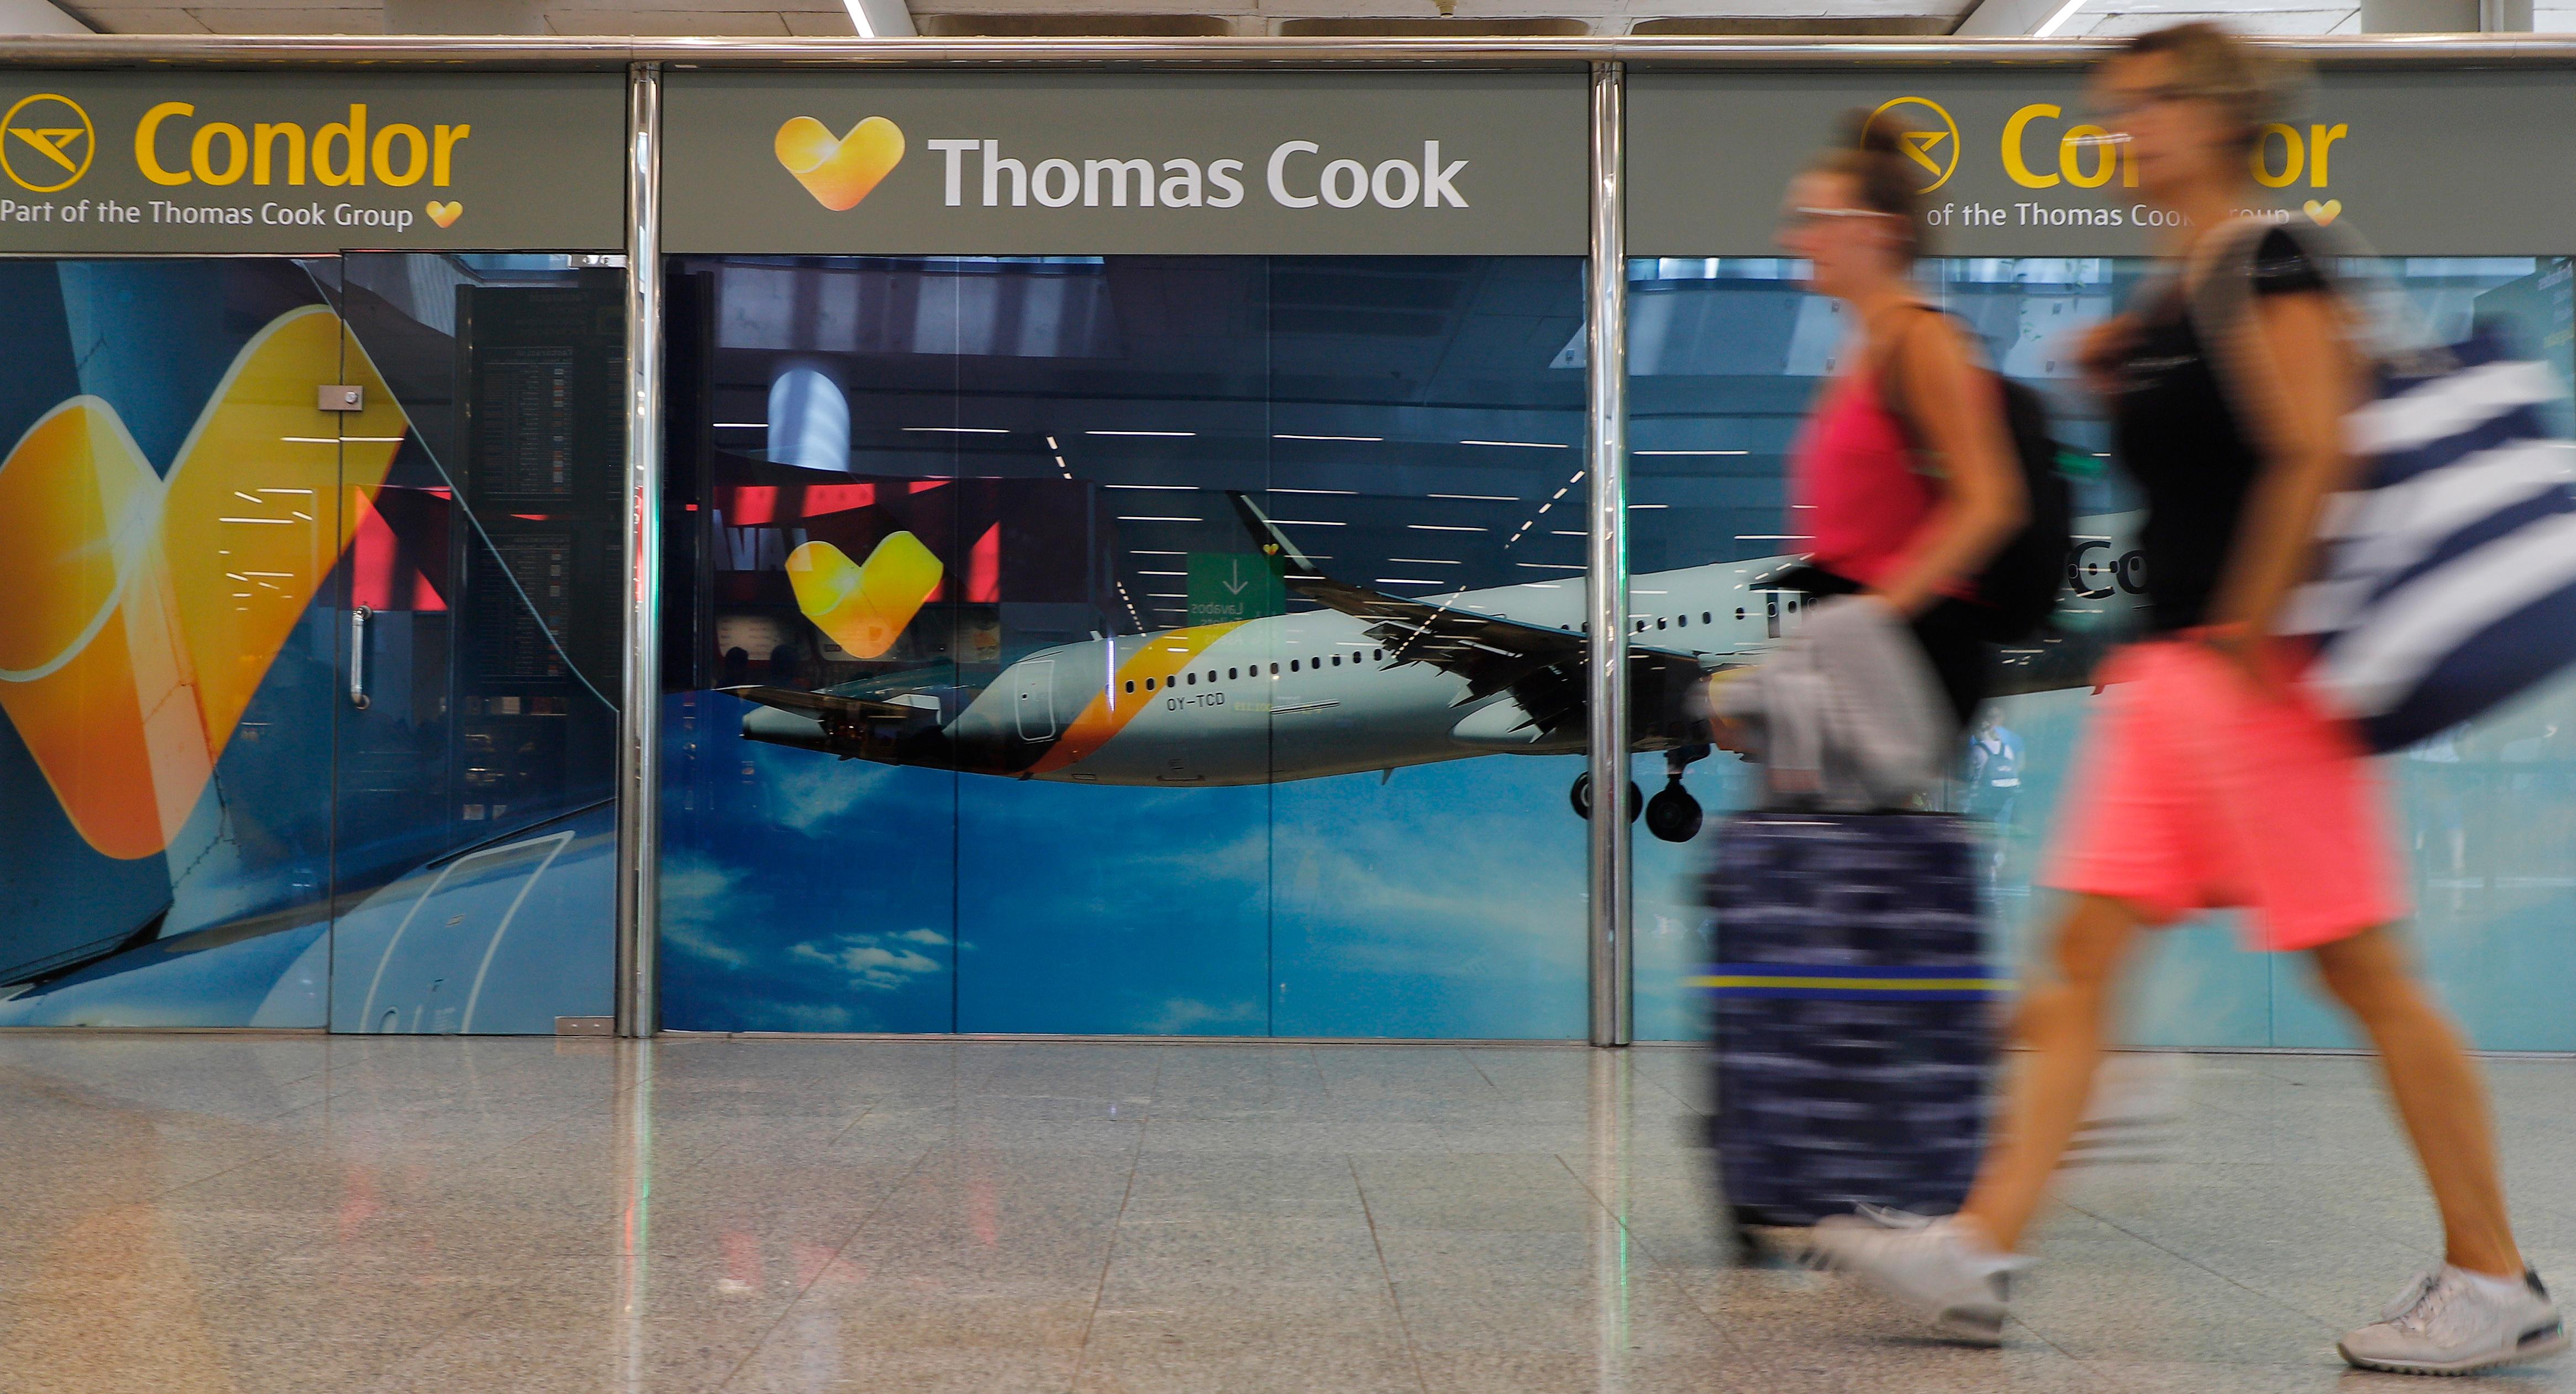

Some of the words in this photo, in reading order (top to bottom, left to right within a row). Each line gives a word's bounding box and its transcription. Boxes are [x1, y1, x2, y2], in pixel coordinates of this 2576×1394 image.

[134, 101, 471, 188] Condor
[2001, 103, 2349, 188] Coor
[927, 139, 1244, 208] Thomas
[1266, 140, 1469, 208] Cook
[1, 199, 54, 222] Part
[61, 199, 91, 223] of
[97, 199, 141, 223] the
[148, 201, 254, 224] Thomas
[261, 202, 327, 225] Cook
[334, 203, 413, 233] Group
[1927, 203, 1954, 226] of
[1962, 202, 2007, 226] the
[2014, 202, 2123, 226] Thomas
[1166, 692, 1226, 712] OY-TCD
